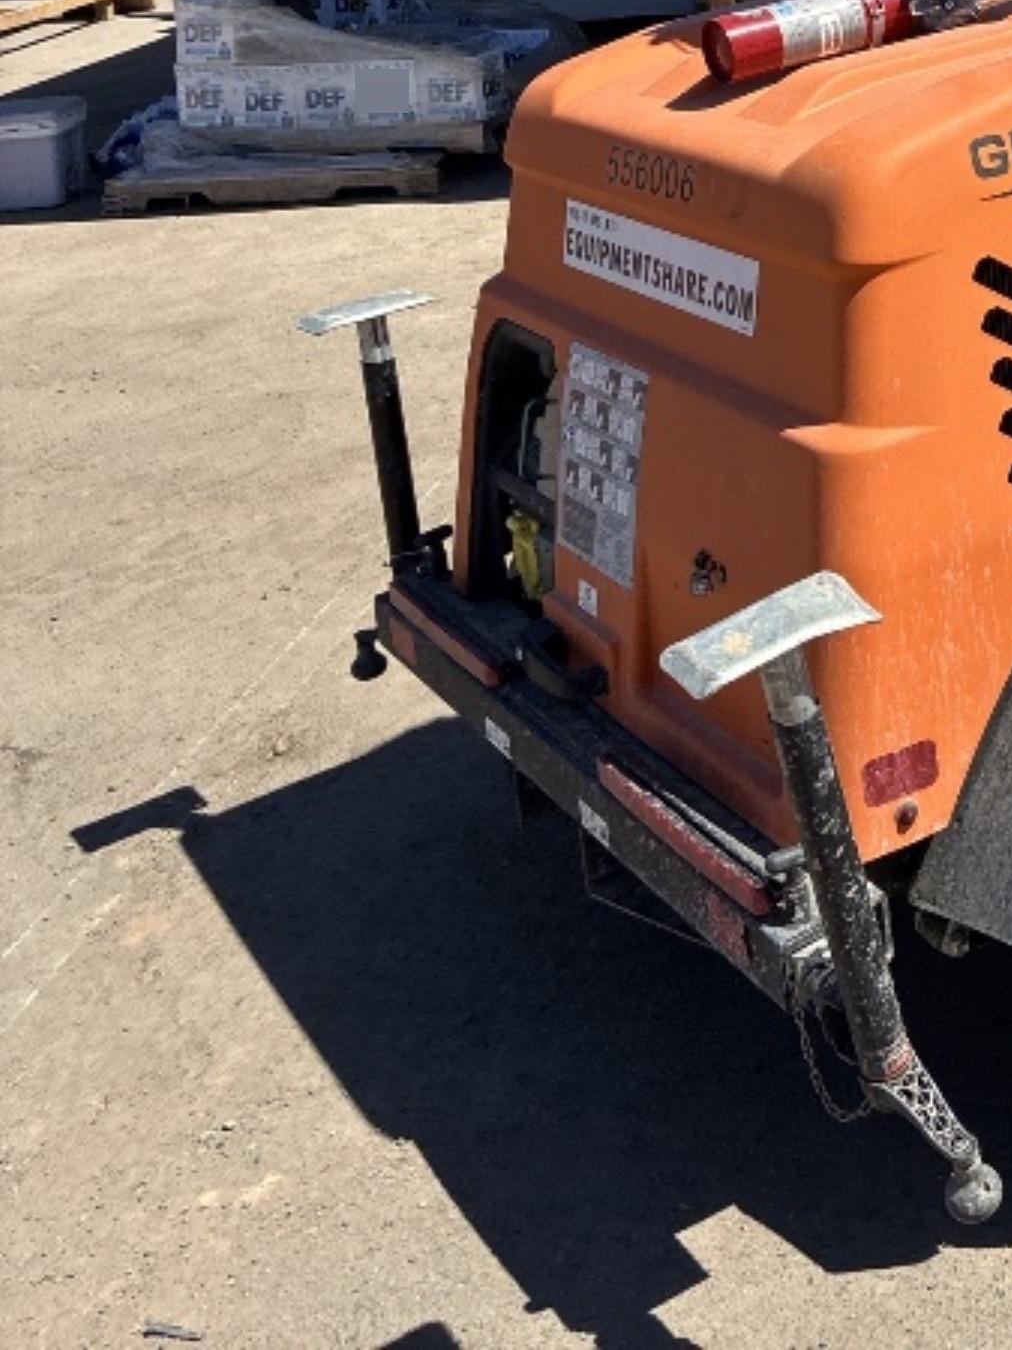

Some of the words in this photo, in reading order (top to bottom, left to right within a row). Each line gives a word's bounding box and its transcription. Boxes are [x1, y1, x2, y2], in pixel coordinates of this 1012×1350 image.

[185, 23, 222, 43] DEF
[186, 88, 224, 108] DEF
[245, 90, 283, 111] DEF
[306, 88, 344, 108] DEF
[428, 81, 467, 102] DEF
[607, 146, 696, 203] 556006
[565, 226, 754, 322] EQUIPMENTSHARE.COM
